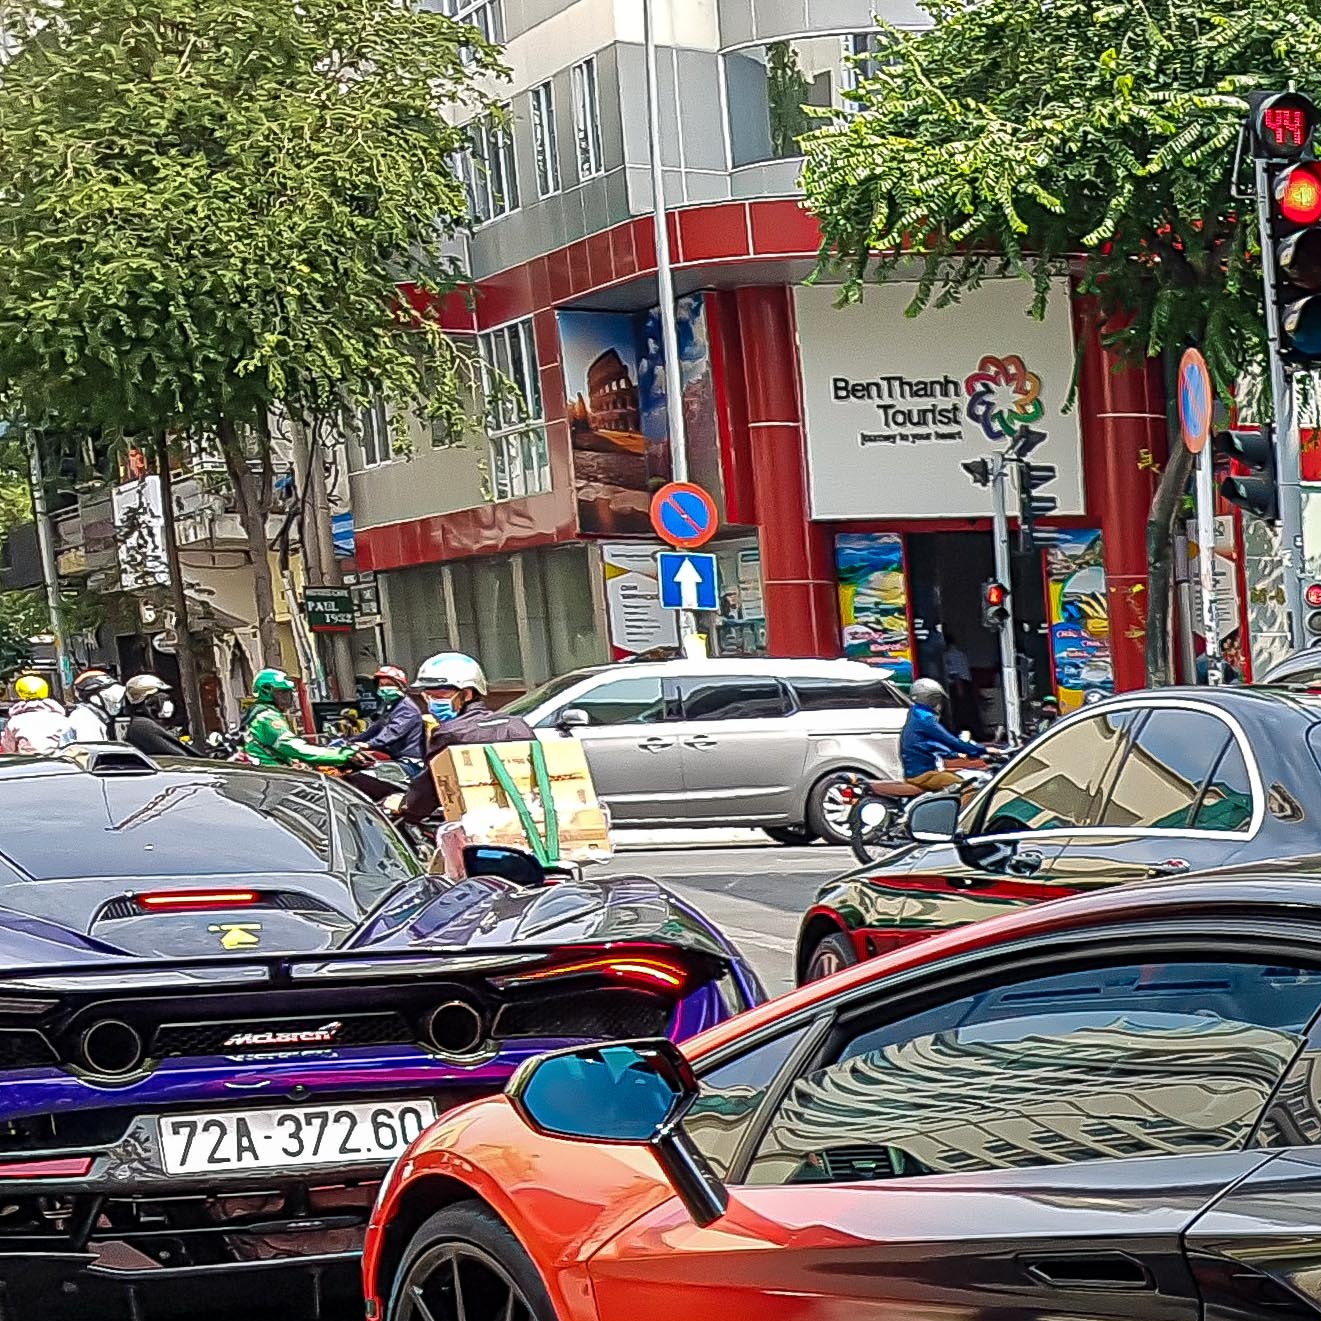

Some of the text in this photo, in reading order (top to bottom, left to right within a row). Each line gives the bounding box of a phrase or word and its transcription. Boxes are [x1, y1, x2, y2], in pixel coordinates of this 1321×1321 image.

[832, 376, 961, 401] BenThanh
[876, 403, 962, 428] Tourist
[223, 1031, 336, 1046] McLaren
[171, 1107, 423, 1167] 72A-372.60
